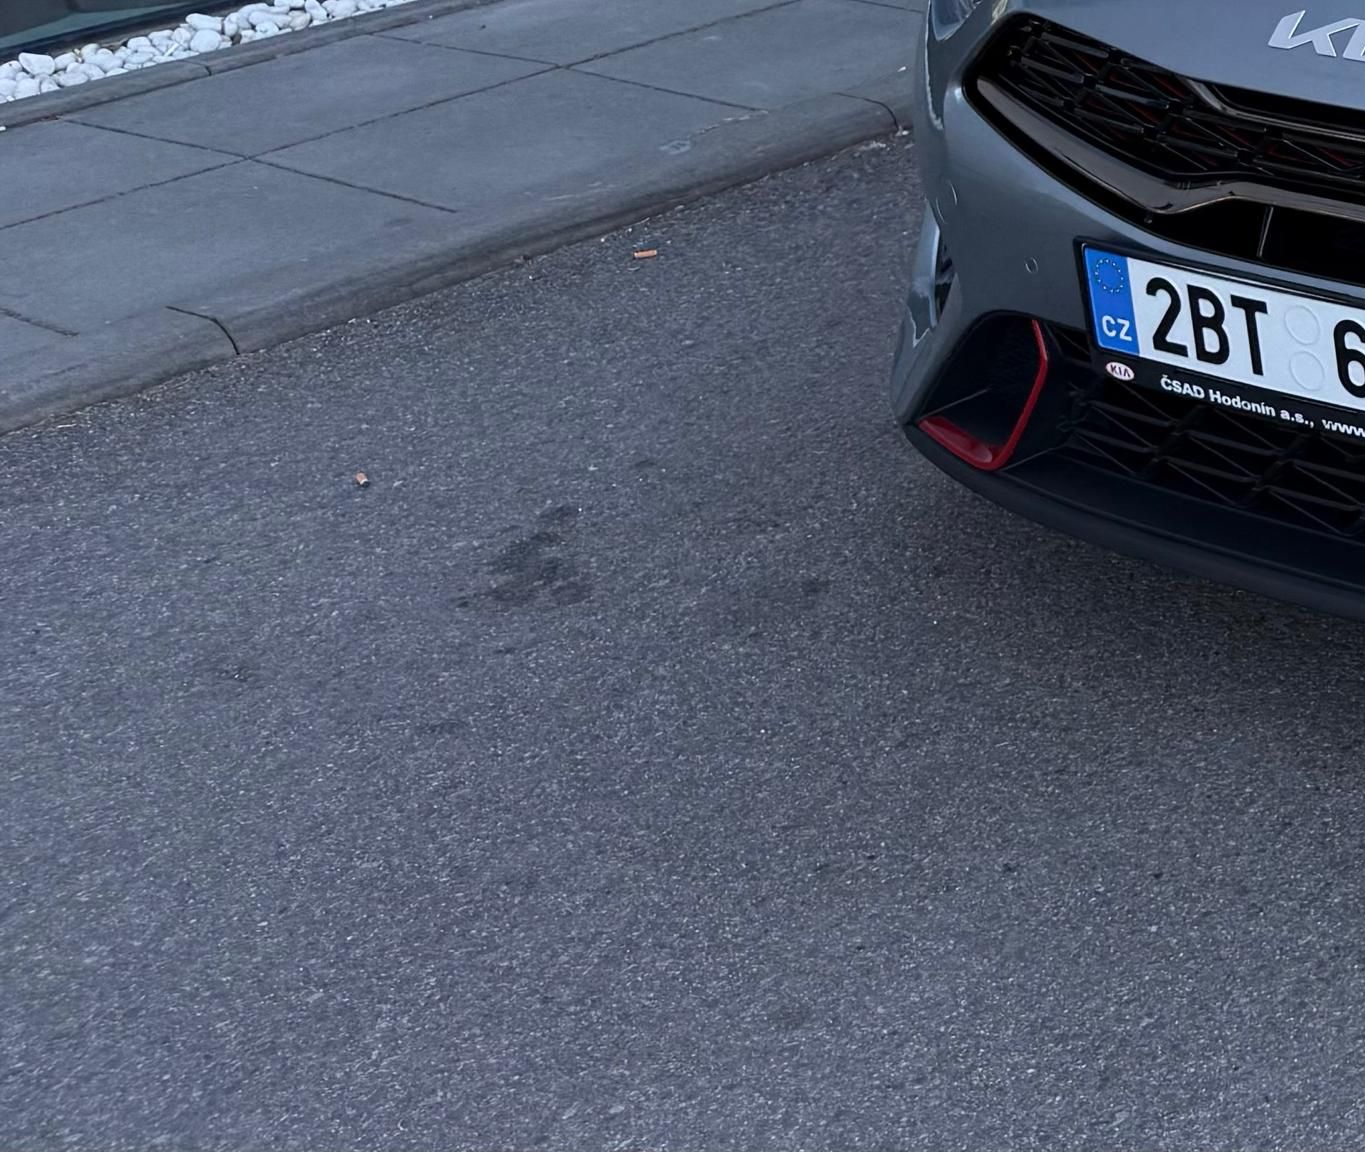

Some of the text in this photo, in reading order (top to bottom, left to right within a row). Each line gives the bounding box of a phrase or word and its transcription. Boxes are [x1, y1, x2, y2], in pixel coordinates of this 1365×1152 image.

[1101, 315, 1133, 342] CZ
[1145, 276, 1269, 377] 2BT
[1108, 363, 1133, 379] KIA
[1160, 373, 1206, 400] ČSAD
[1208, 388, 1277, 418] Hodonín
[1279, 409, 1315, 429] a.s.,
